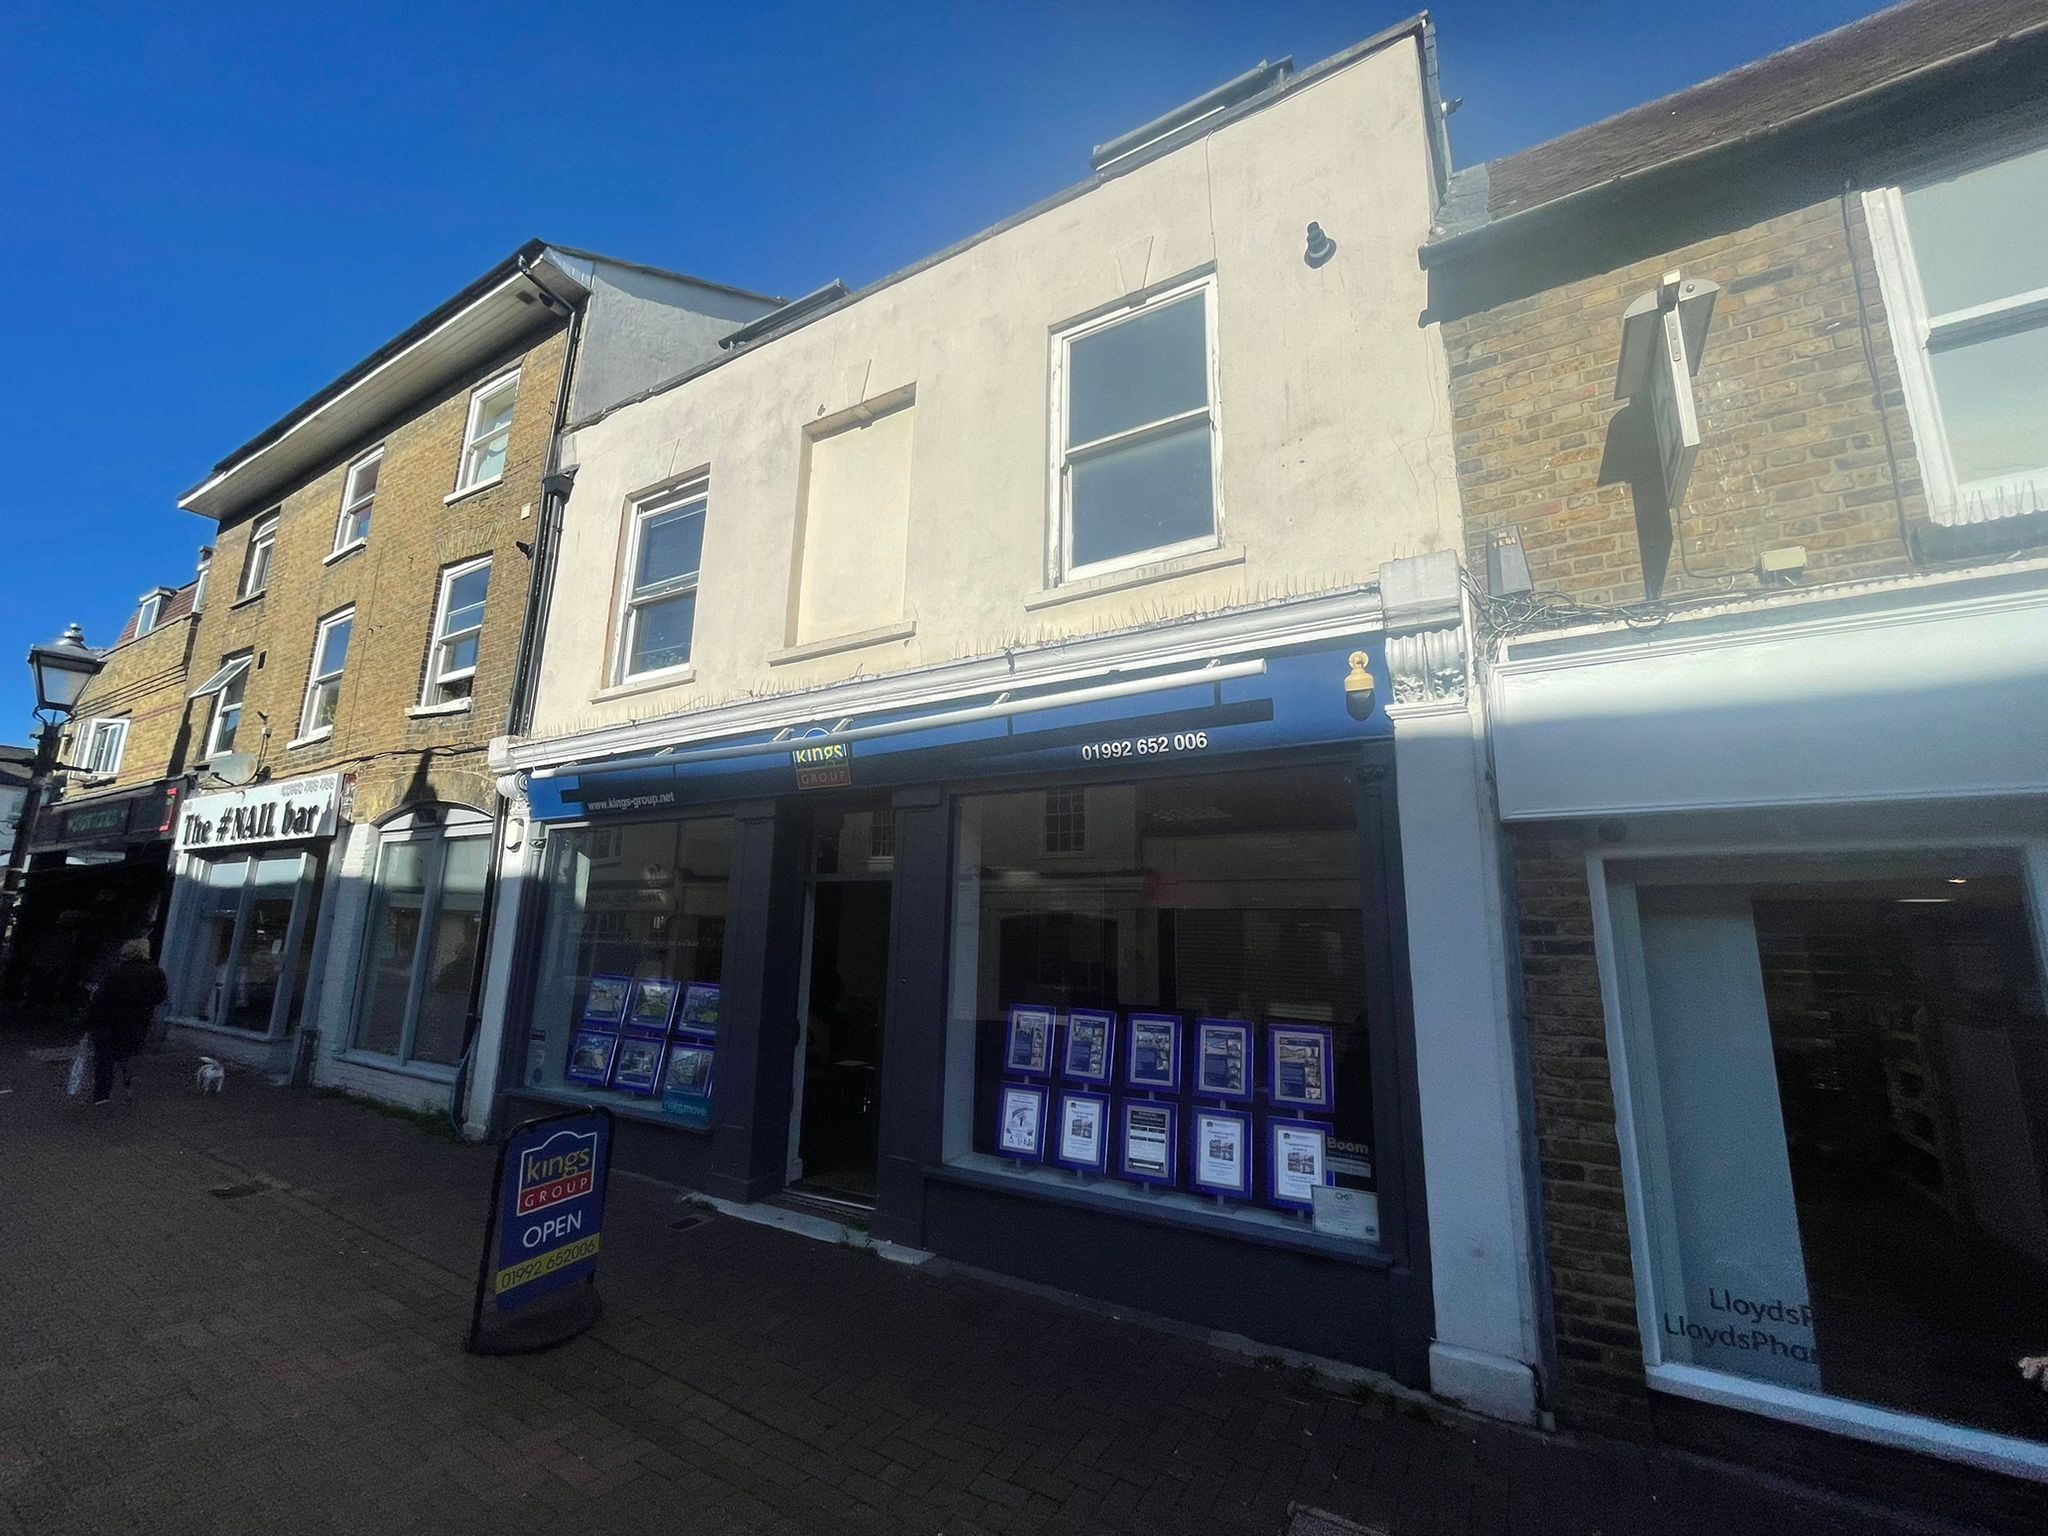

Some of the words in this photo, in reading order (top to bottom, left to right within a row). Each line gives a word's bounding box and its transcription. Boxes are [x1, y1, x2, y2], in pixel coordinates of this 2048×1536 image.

[796, 744, 843, 767] kings
[1082, 741, 1132, 760] 01992
[1137, 736, 1169, 755] 652
[1174, 732, 1208, 751] 006
[801, 771, 846, 784] GROUP
[587, 791, 676, 811] www.kings-group.net
[183, 814, 214, 846] The
[216, 801, 278, 843] #NAIL
[282, 799, 319, 836] bar
[526, 1148, 590, 1184] kings
[524, 1177, 588, 1208] GROUP
[522, 1210, 582, 1248] OPEN
[501, 1260, 543, 1289] 01992
[547, 1240, 596, 1270] 652006
